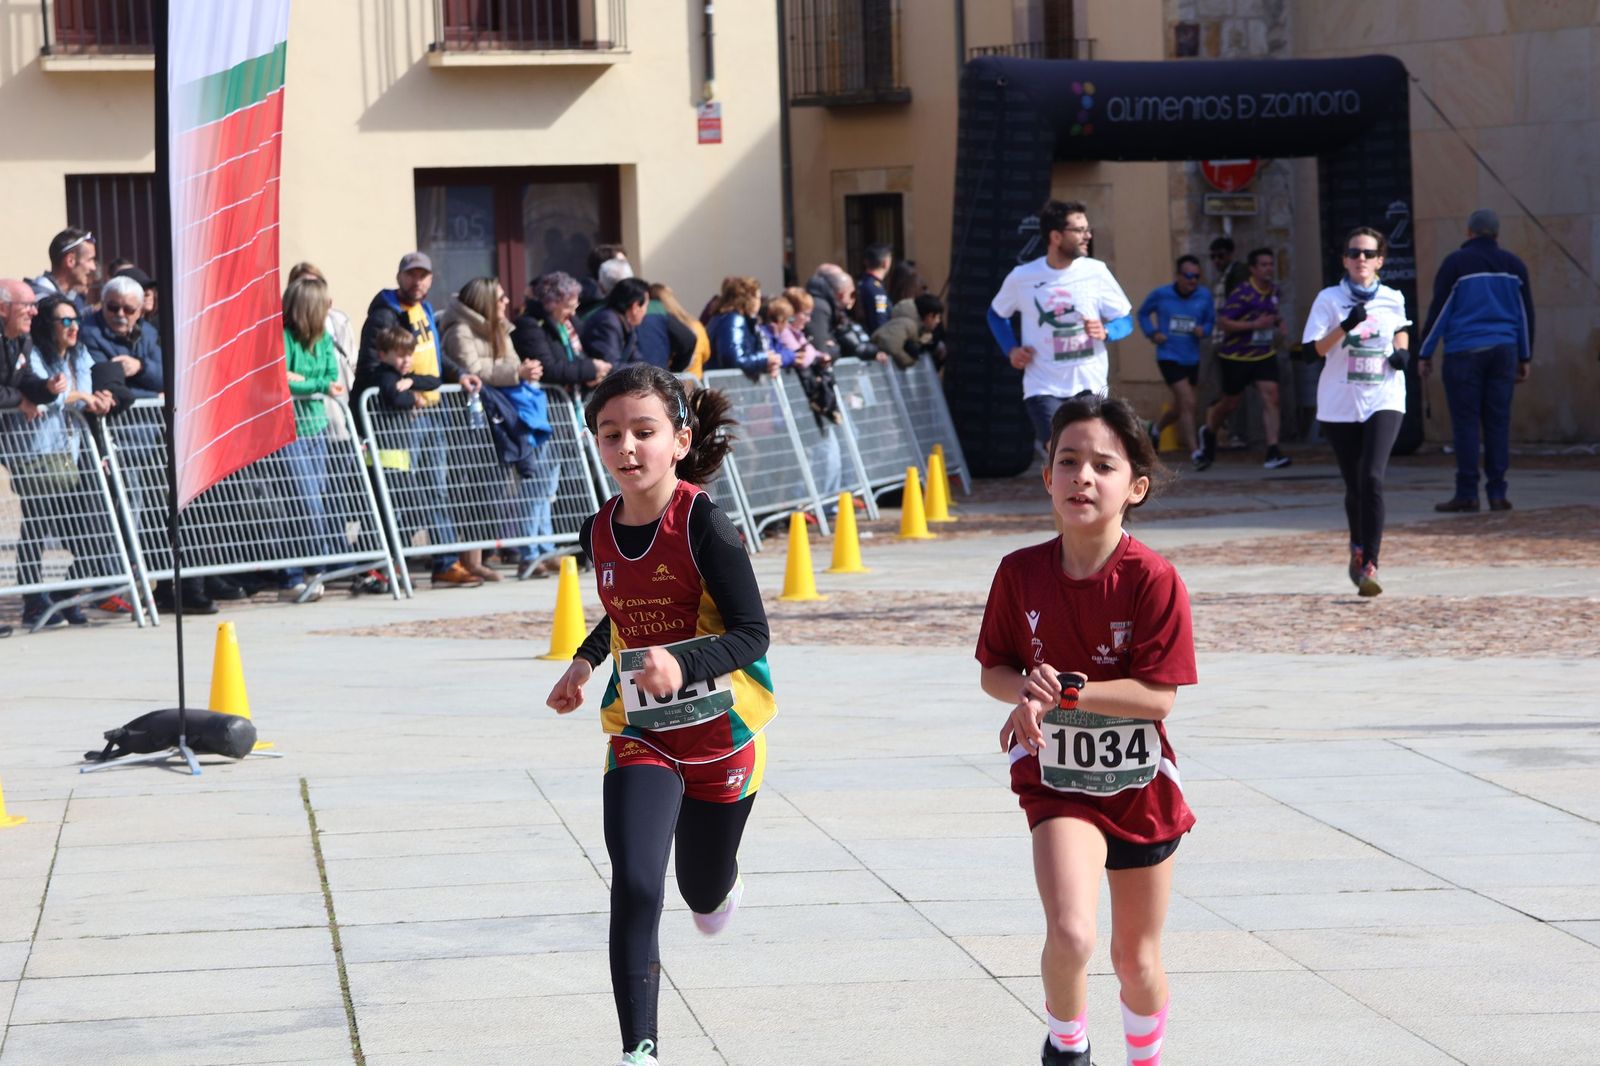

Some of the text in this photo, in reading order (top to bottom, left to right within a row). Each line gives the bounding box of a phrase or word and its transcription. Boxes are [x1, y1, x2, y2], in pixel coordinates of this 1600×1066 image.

[1260, 89, 1361, 118] zamora
[621, 618, 685, 637] DE TORO
[628, 610, 666, 624] VINO
[1051, 727, 1150, 769] 1034
